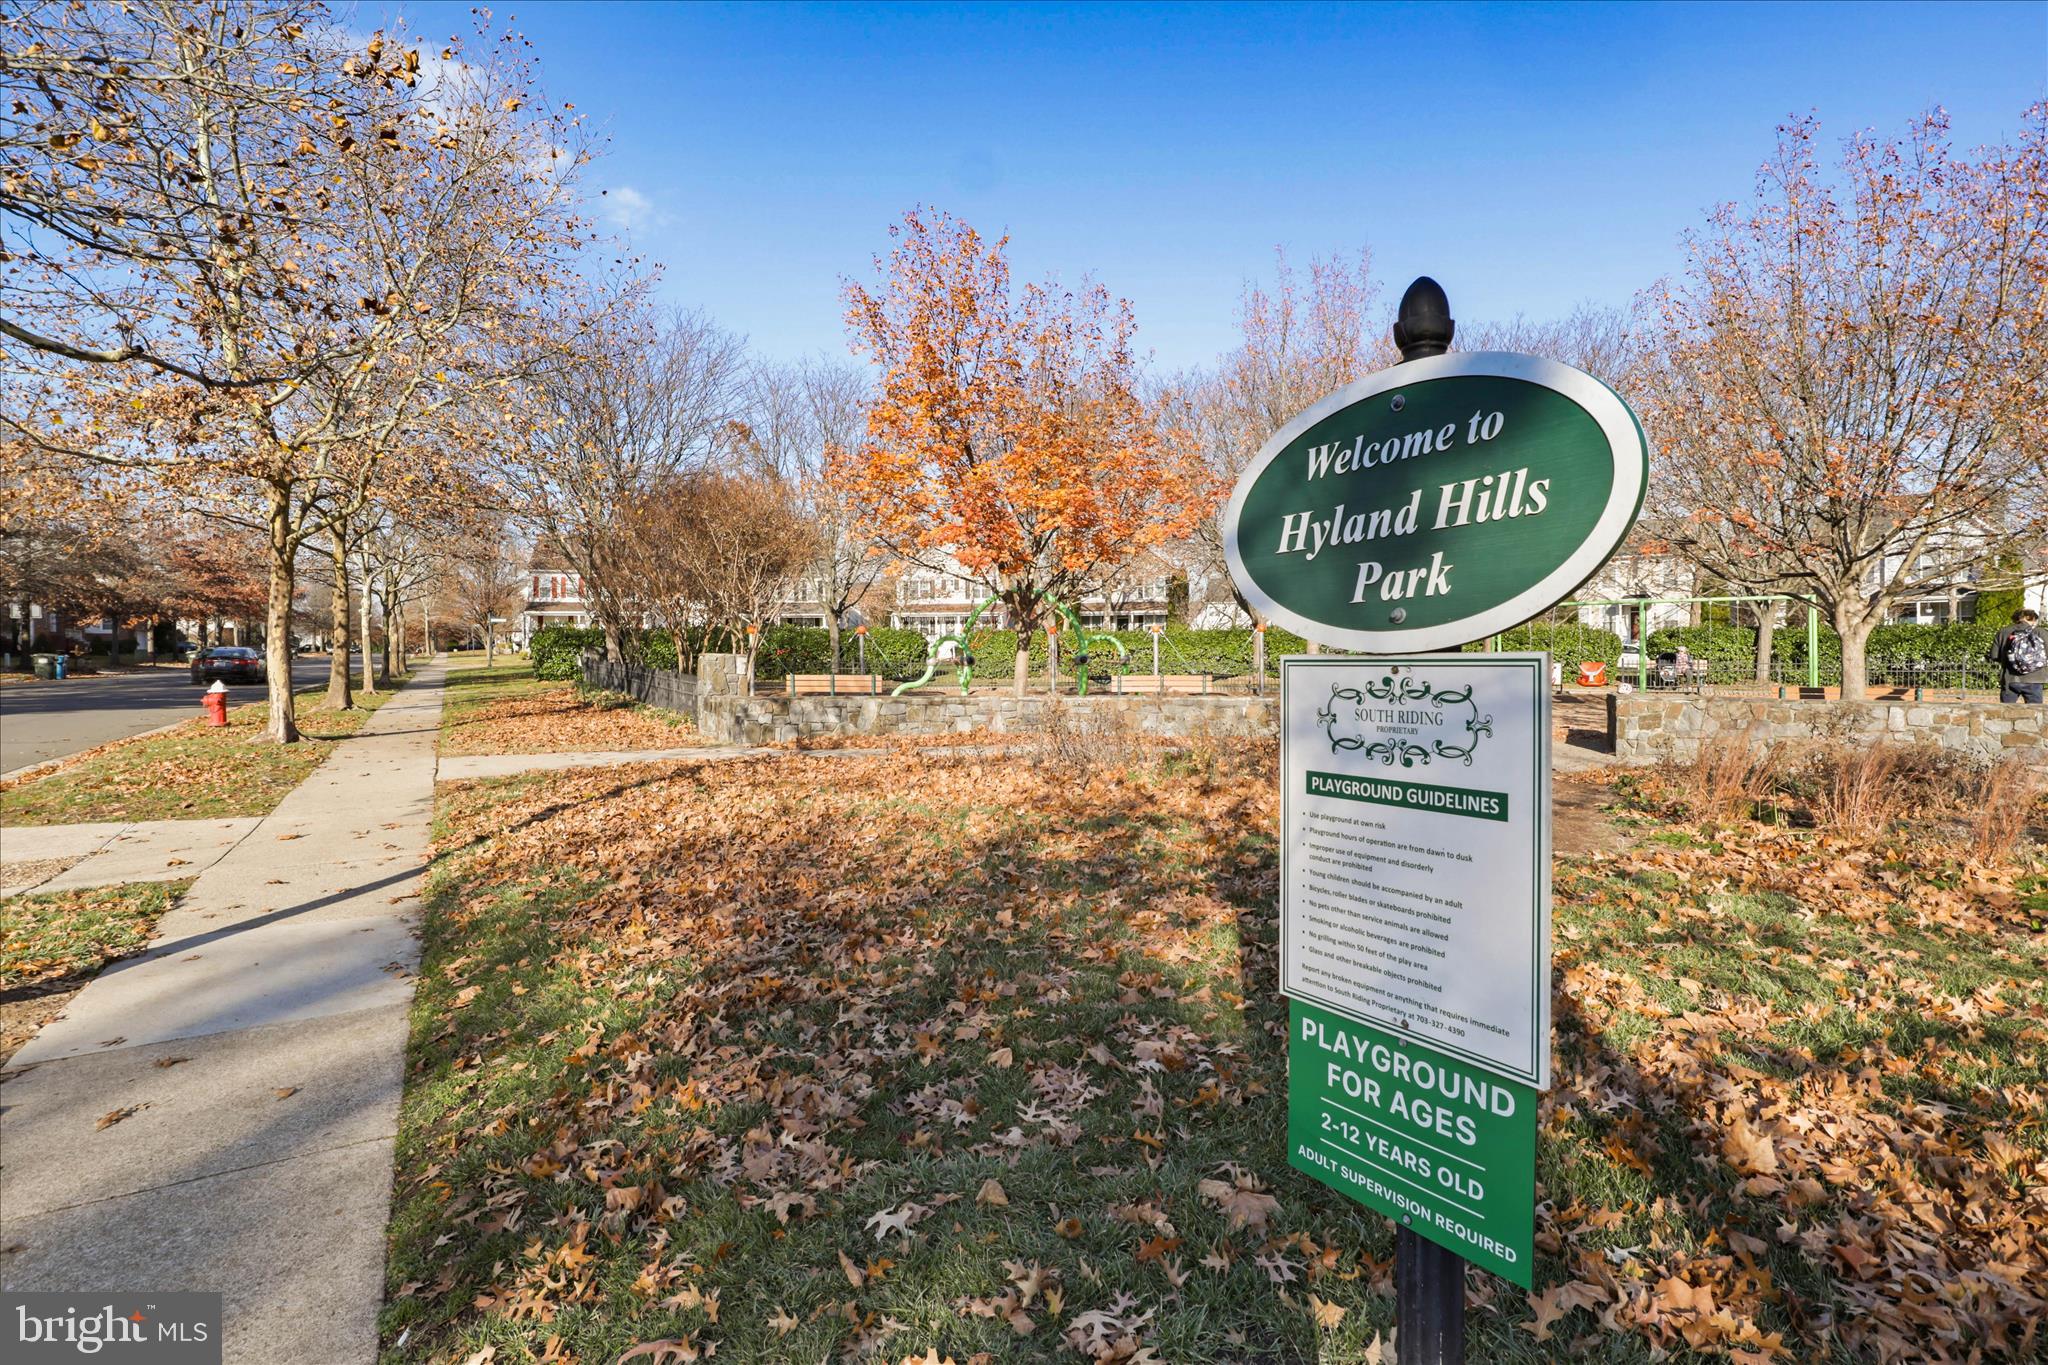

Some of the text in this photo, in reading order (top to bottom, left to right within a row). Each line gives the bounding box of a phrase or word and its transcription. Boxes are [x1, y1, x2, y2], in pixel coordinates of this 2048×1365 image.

[1307, 409, 1504, 481] Welcome to
[1276, 467, 1551, 561] Hyland Hills
[1349, 551, 1454, 603] Park
[1354, 708, 1443, 726] SOUTH RIDING
[1376, 726, 1419, 735] PROPRIETARY
[1312, 777, 1499, 813] PLAYGROUND GUIDELINES
[1309, 811, 1319, 819] Use
[1320, 814, 1352, 824] playground
[1375, 822, 1386, 830] risk
[1309, 827, 1340, 838] Playground
[1341, 832, 1357, 841] hours
[1366, 838, 1396, 849] operation
[1397, 843, 1407, 851] are
[1409, 844, 1425, 853] from
[1426, 848, 1445, 857] dawn
[1447, 851, 1454, 859] to
[1456, 853, 1473, 862] dusk
[1309, 842, 1335, 853] Improper
[1354, 852, 1387, 863] equipment
[1388, 858, 1400, 866] and
[1401, 860, 1434, 874] disorderly
[1309, 854, 1331, 863] conduct
[1342, 861, 1373, 872] prohibited
[1309, 869, 1326, 879] Young
[1327, 873, 1350, 883] children
[1351, 878, 1371, 889] should
[1372, 882, 1380, 890] be
[1381, 886, 1423, 900] accompanied
[1424, 894, 1433, 903] by
[1445, 899, 1463, 909] adult
[1332, 891, 1347, 899] roller
[1348, 894, 1367, 904] blades
[1377, 901, 1415, 915] skateboards
[1416, 911, 1451, 924] prohibited
[1309, 915, 1332, 928] Smoking
[1340, 924, 1365, 936] alcoholic
[1367, 929, 1397, 944] beverages
[1399, 940, 1409, 948] are
[1410, 944, 1445, 958] prohibited
[1318, 903, 1329, 911] pets
[1331, 906, 1346, 914] other
[1347, 909, 1361, 918] than
[1362, 914, 1382, 924] service
[1384, 919, 1408, 931] animals
[1410, 926, 1420, 934] are
[1422, 928, 1449, 941] allowed
[1309, 930, 1316, 938] No
[1318, 934, 1336, 945] grilling
[1338, 940, 1356, 950] within
[1357, 944, 1364, 952] 50
[1365, 947, 1377, 956] feet
[1387, 953, 1397, 961] the
[1398, 957, 1412, 967] play
[1413, 962, 1428, 971] area
[1309, 946, 1442, 993] Glass and other breakable objects prohibited
[1302, 977, 1326, 989] attention
[1335, 987, 1351, 998] South
[1352, 993, 1370, 1006] Riding
[1371, 999, 1406, 1018] Proprietary
[1302, 963, 1320, 974] Report
[1321, 970, 1331, 978] any
[1332, 972, 1352, 984] broken
[1353, 980, 1385, 996] equipment
[1395, 994, 1423, 1009] anything
[1424, 1002, 1438, 1013] that
[1440, 1009, 1468, 1024] requires
[1470, 1017, 1510, 1037] immediate
[1302, 1017, 1516, 1118] PLAYGROUND
[1327, 1063, 1477, 1146] FOR AGES
[1321, 1112, 1484, 1201] 2-12 YEARS OLD
[1298, 1144, 1517, 1263] ADULT SUPERVISION REQUIRED
